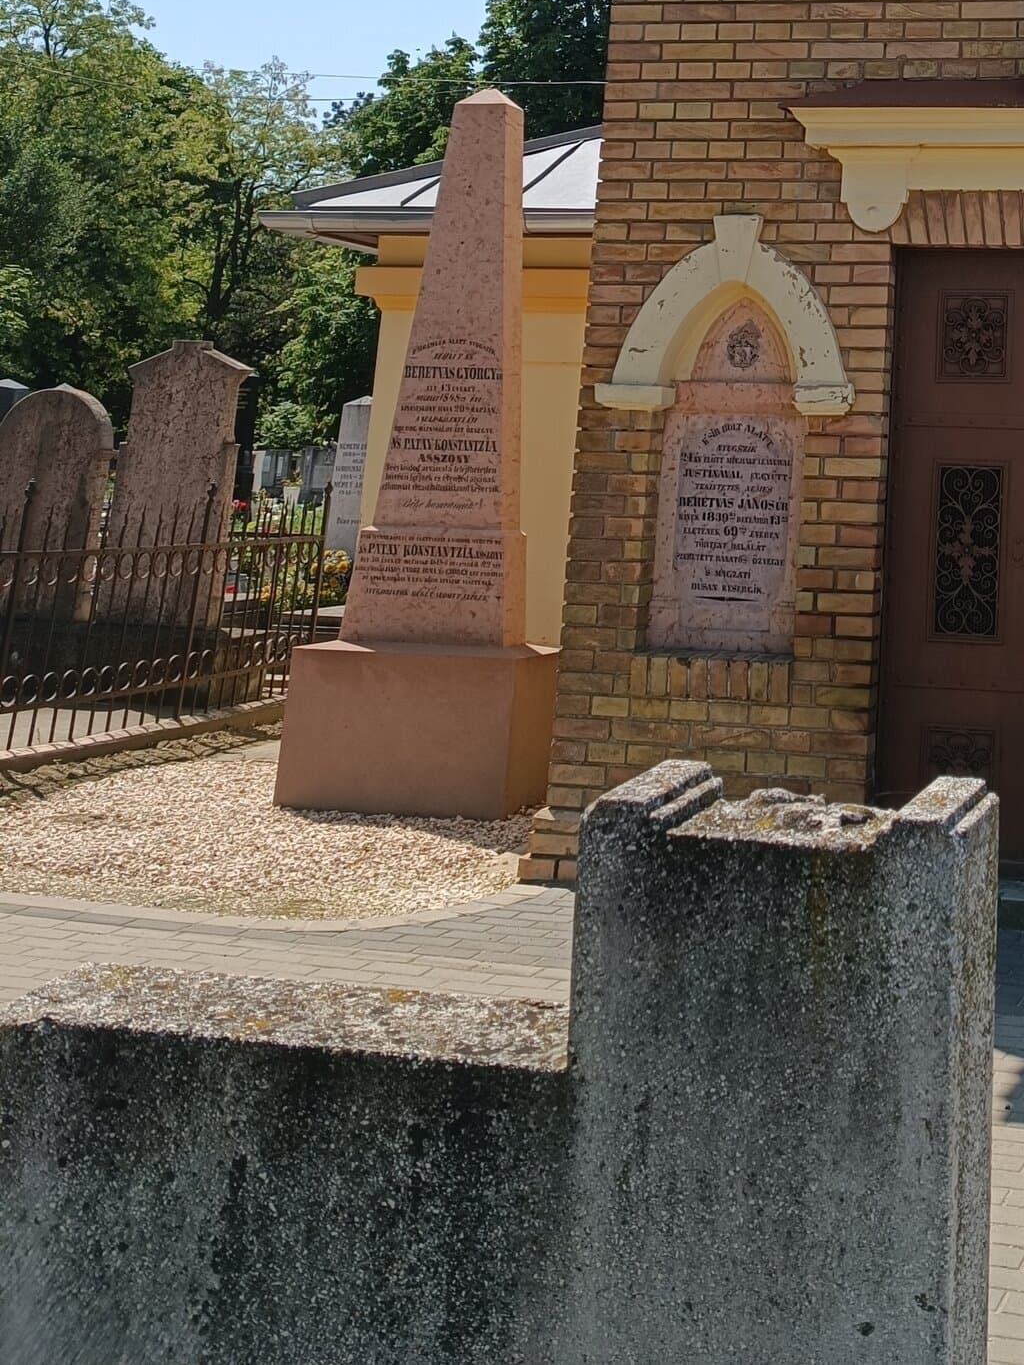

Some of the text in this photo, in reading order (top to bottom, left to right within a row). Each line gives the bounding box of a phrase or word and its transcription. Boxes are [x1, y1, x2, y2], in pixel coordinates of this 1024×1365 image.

[418, 453, 470, 464] ASSZONY
[679, 492, 735, 508] BERETVÁS
[738, 494, 774, 510] JÁNOS
